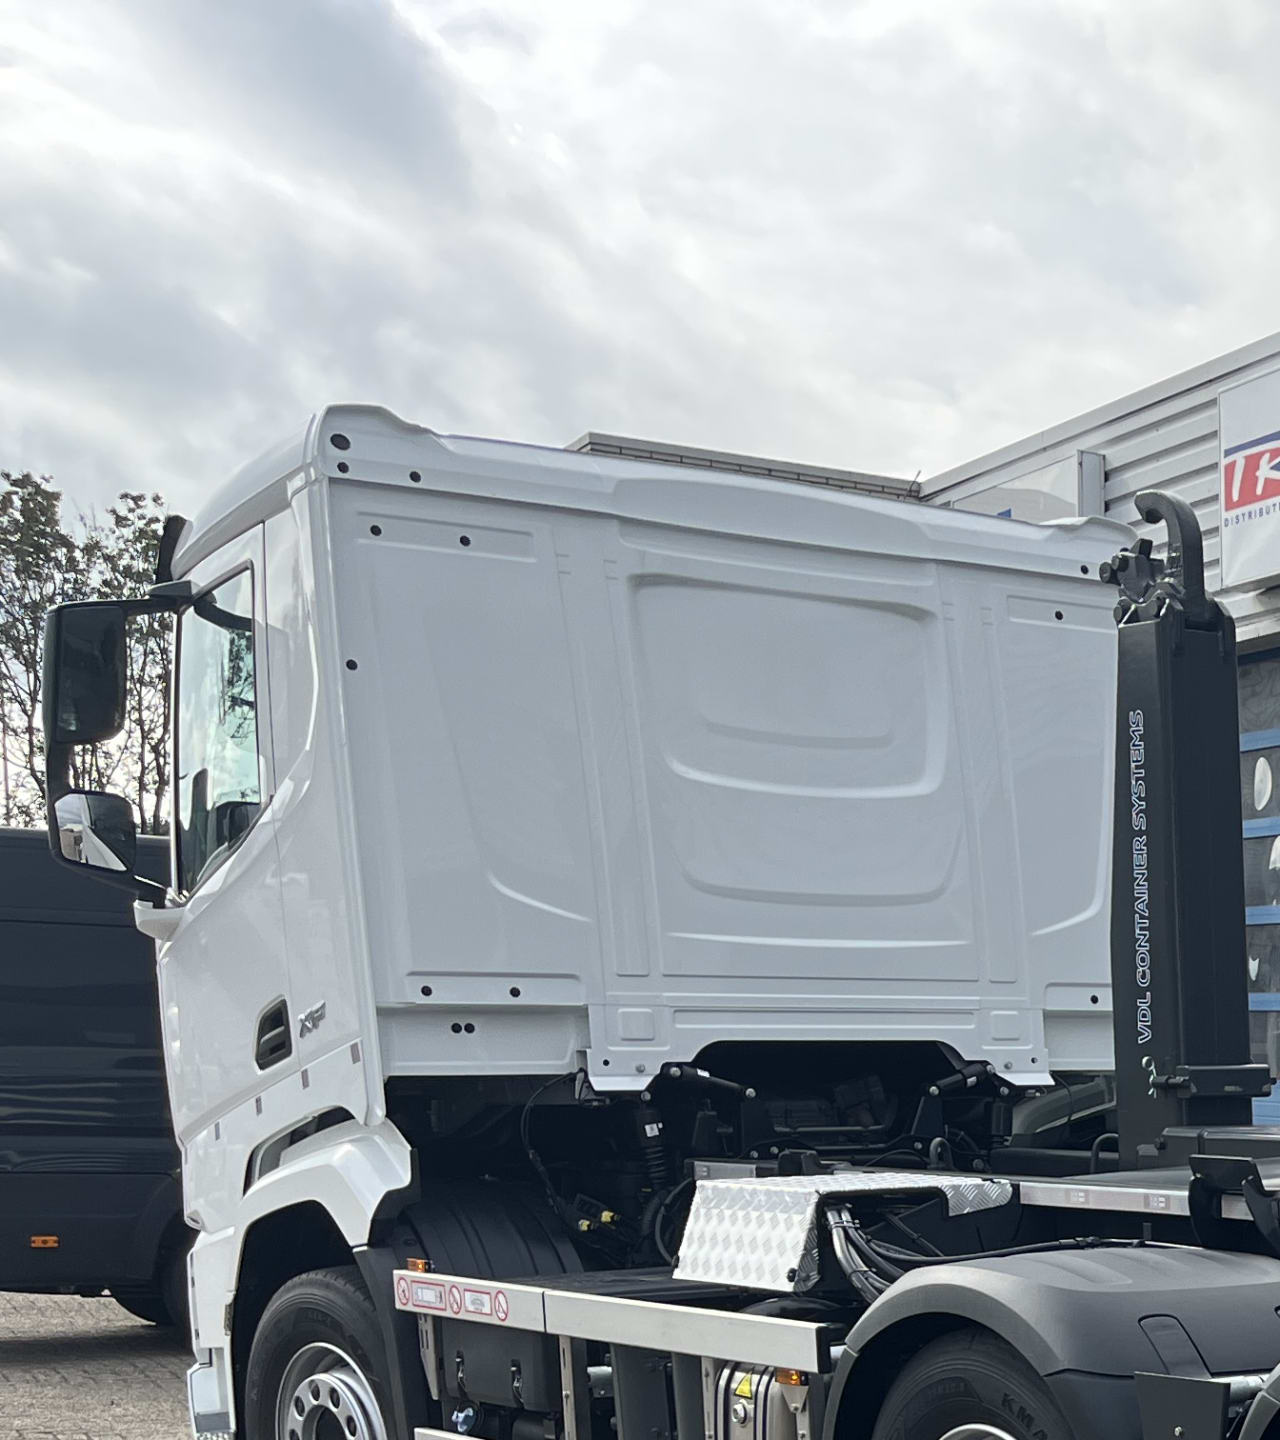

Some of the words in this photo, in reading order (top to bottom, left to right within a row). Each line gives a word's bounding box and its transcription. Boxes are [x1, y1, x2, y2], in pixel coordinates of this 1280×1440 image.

[1129, 708, 1147, 831] SYSTEMS
[1132, 834, 1151, 987] CONTAINER
[1137, 991, 1152, 1045] VDL
